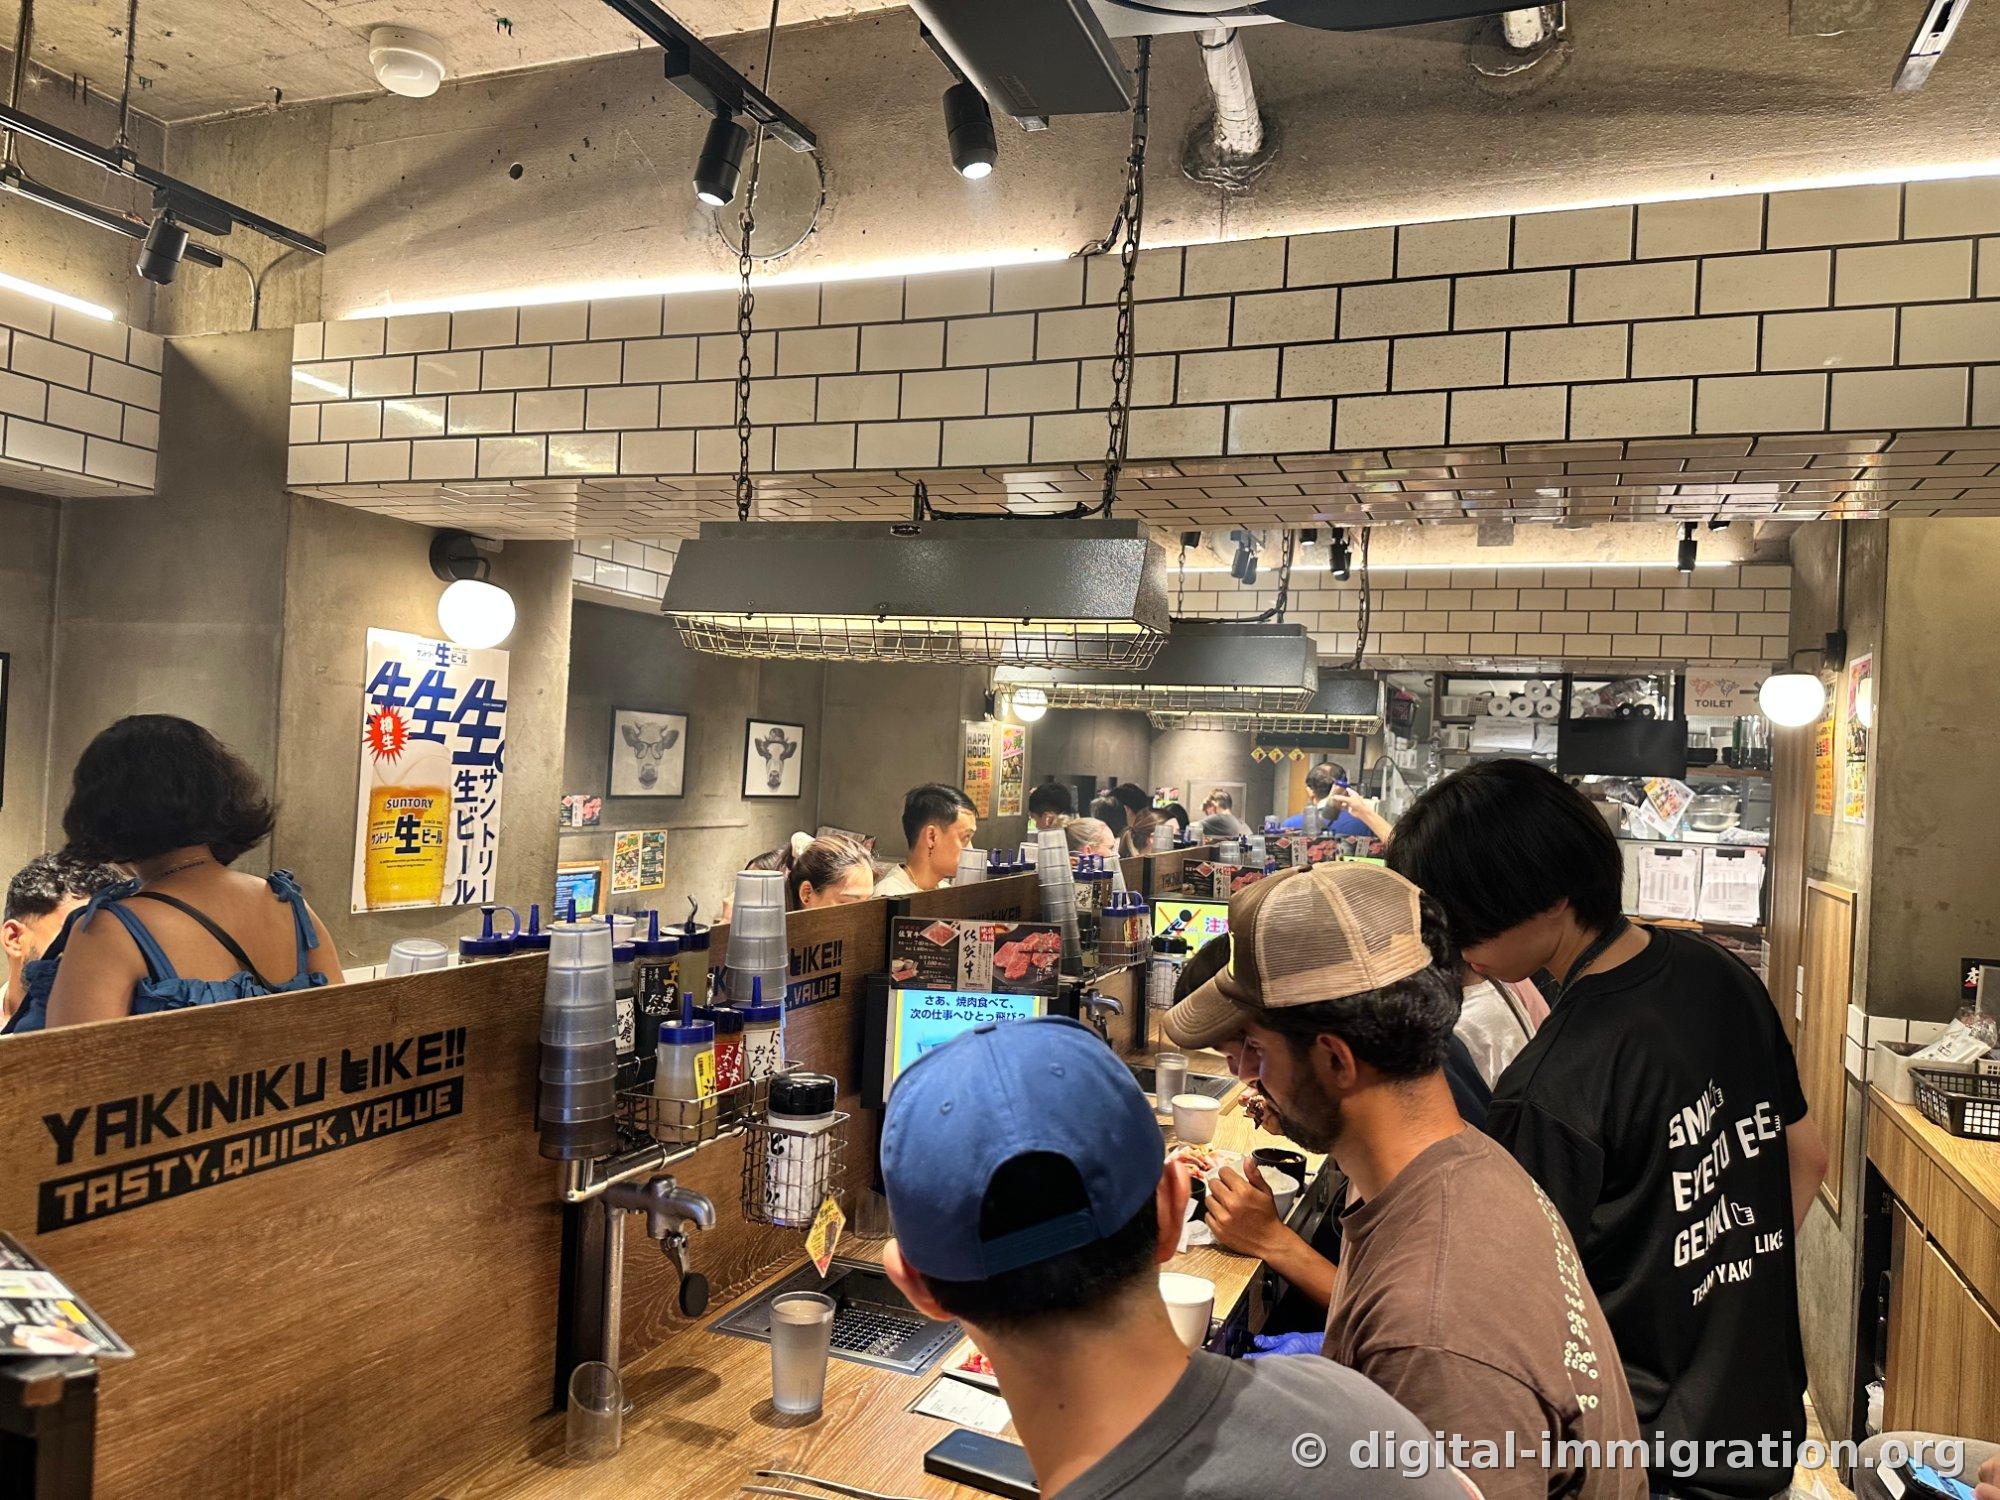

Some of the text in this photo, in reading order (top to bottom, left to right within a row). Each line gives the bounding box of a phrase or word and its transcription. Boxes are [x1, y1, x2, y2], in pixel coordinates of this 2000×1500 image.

[1694, 699, 1733, 708] TOILET
[966, 733, 991, 746] HAPPY
[386, 798, 433, 809] SUNTORY
[452, 769, 479, 905] 生ビール
[480, 769, 497, 902] サントリー
[924, 995, 1014, 1009] さあ、焼肉食べて、
[750, 1045, 766, 1078] おろし
[42, 1056, 327, 1166] YAKINIKU
[1674, 1193, 1732, 1267] GENKI
